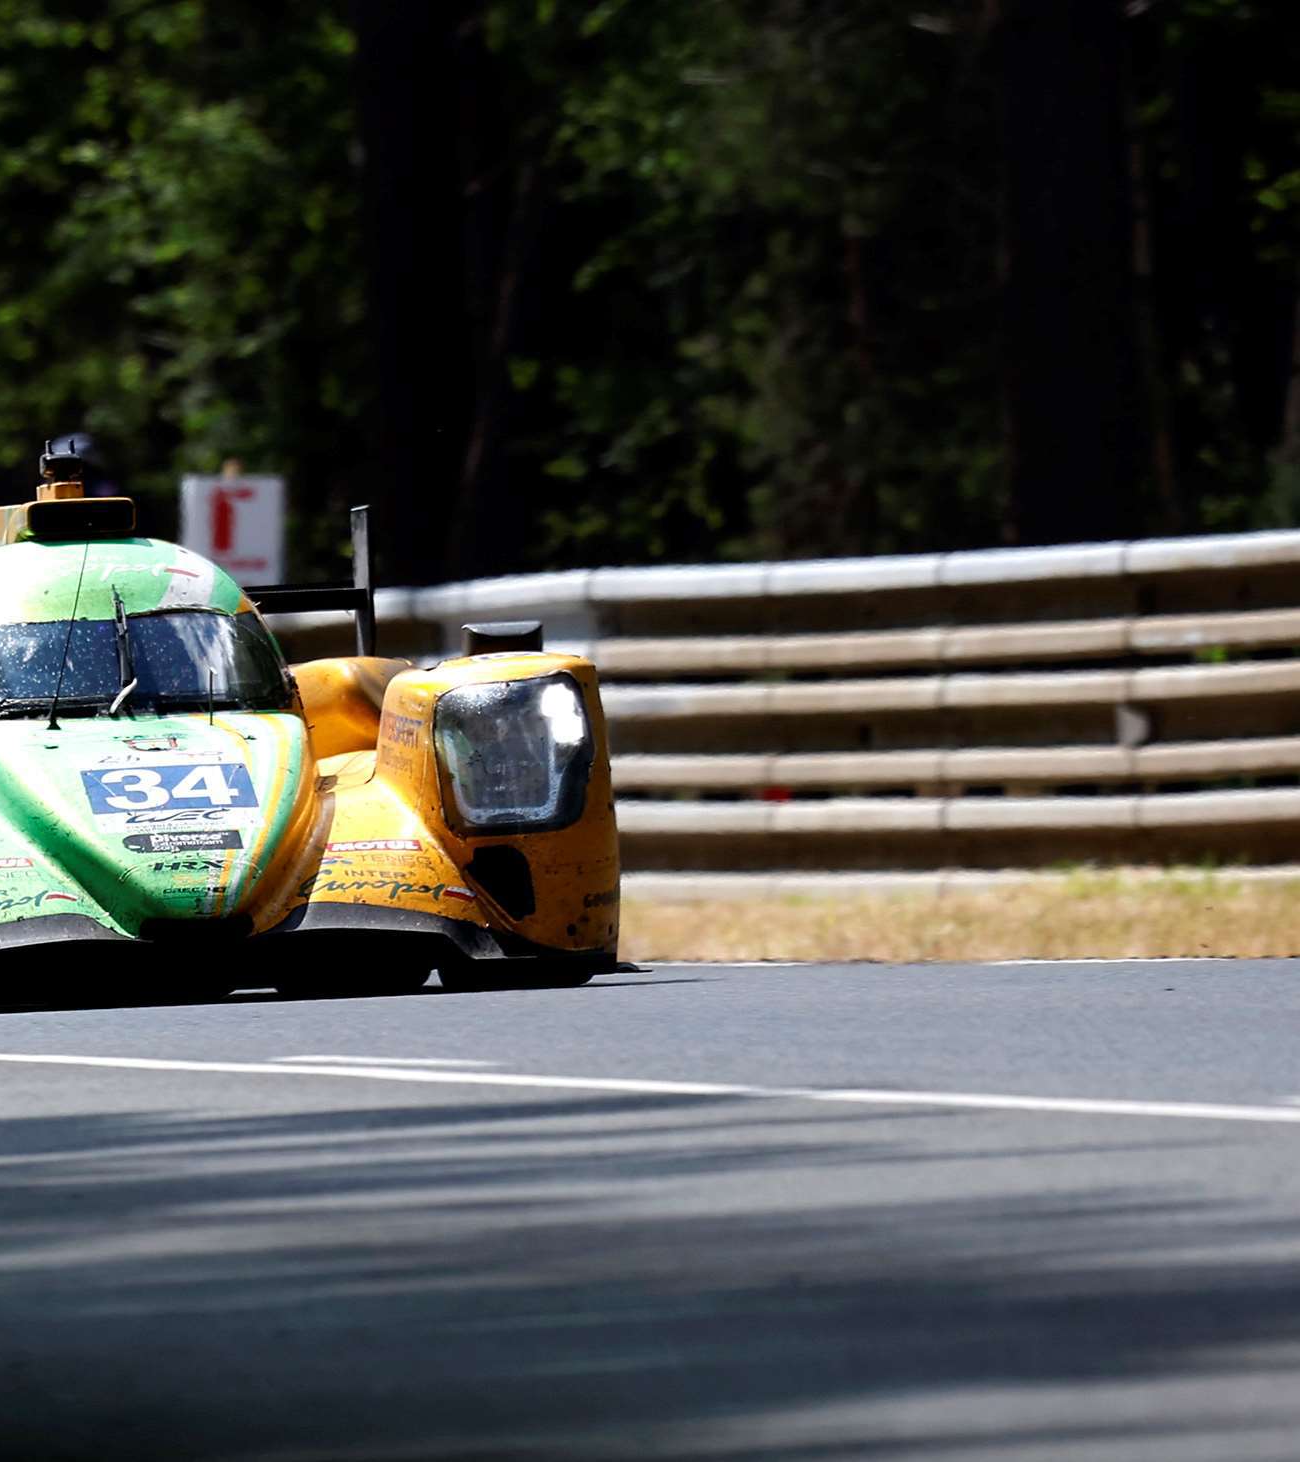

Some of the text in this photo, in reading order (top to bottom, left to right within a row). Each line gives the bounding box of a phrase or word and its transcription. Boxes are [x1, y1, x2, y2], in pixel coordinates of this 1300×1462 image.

[101, 765, 239, 810] 34
[125, 808, 230, 824] WEC
[331, 840, 420, 851] MOTUL
[153, 859, 226, 871] HRX
[345, 869, 411, 879] INTER
